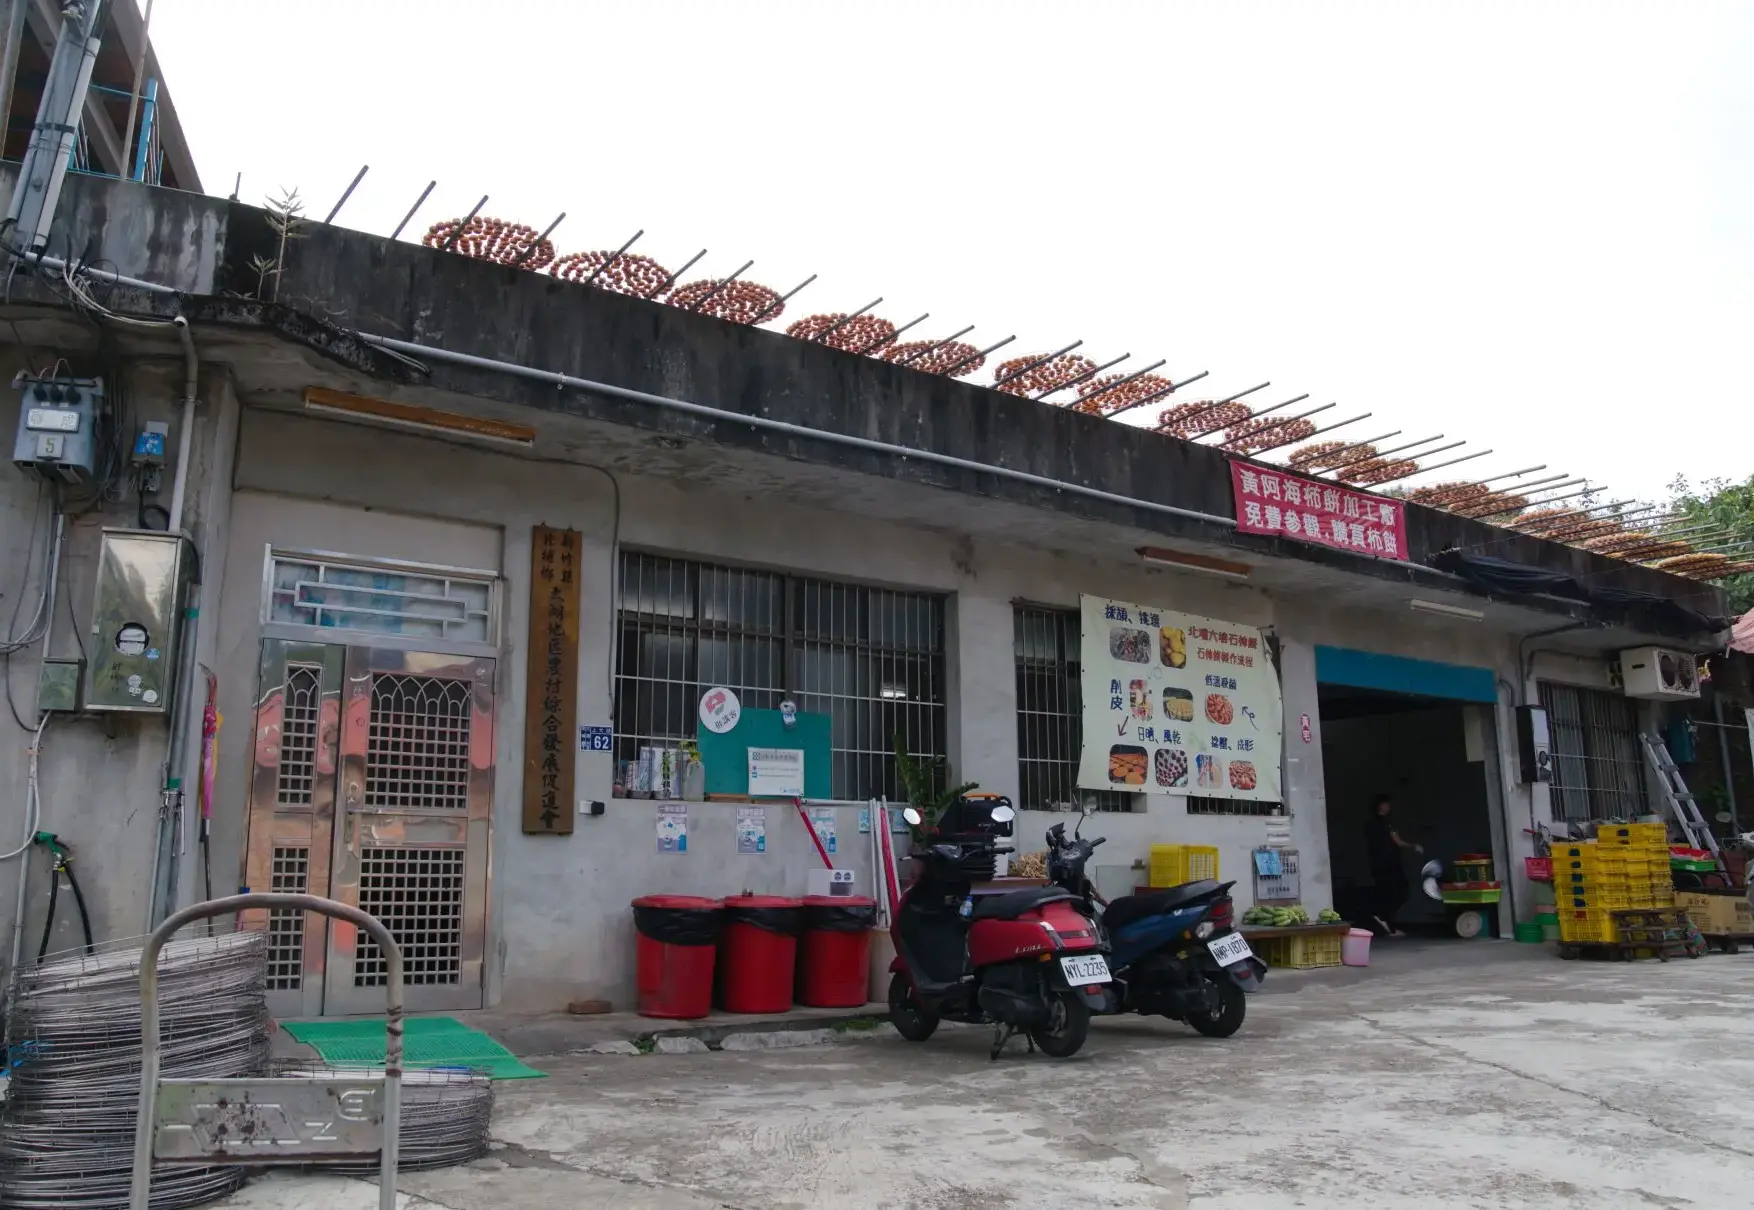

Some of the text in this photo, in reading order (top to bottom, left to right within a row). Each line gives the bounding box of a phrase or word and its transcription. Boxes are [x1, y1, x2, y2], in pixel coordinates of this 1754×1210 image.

[46, 437, 56, 453] 5
[1239, 468, 1396, 524] 黃阿海柿餅加工廠
[1110, 678, 1123, 711] 削皮
[594, 736, 609, 749] 62
[1064, 961, 1108, 979] NYL-2235
